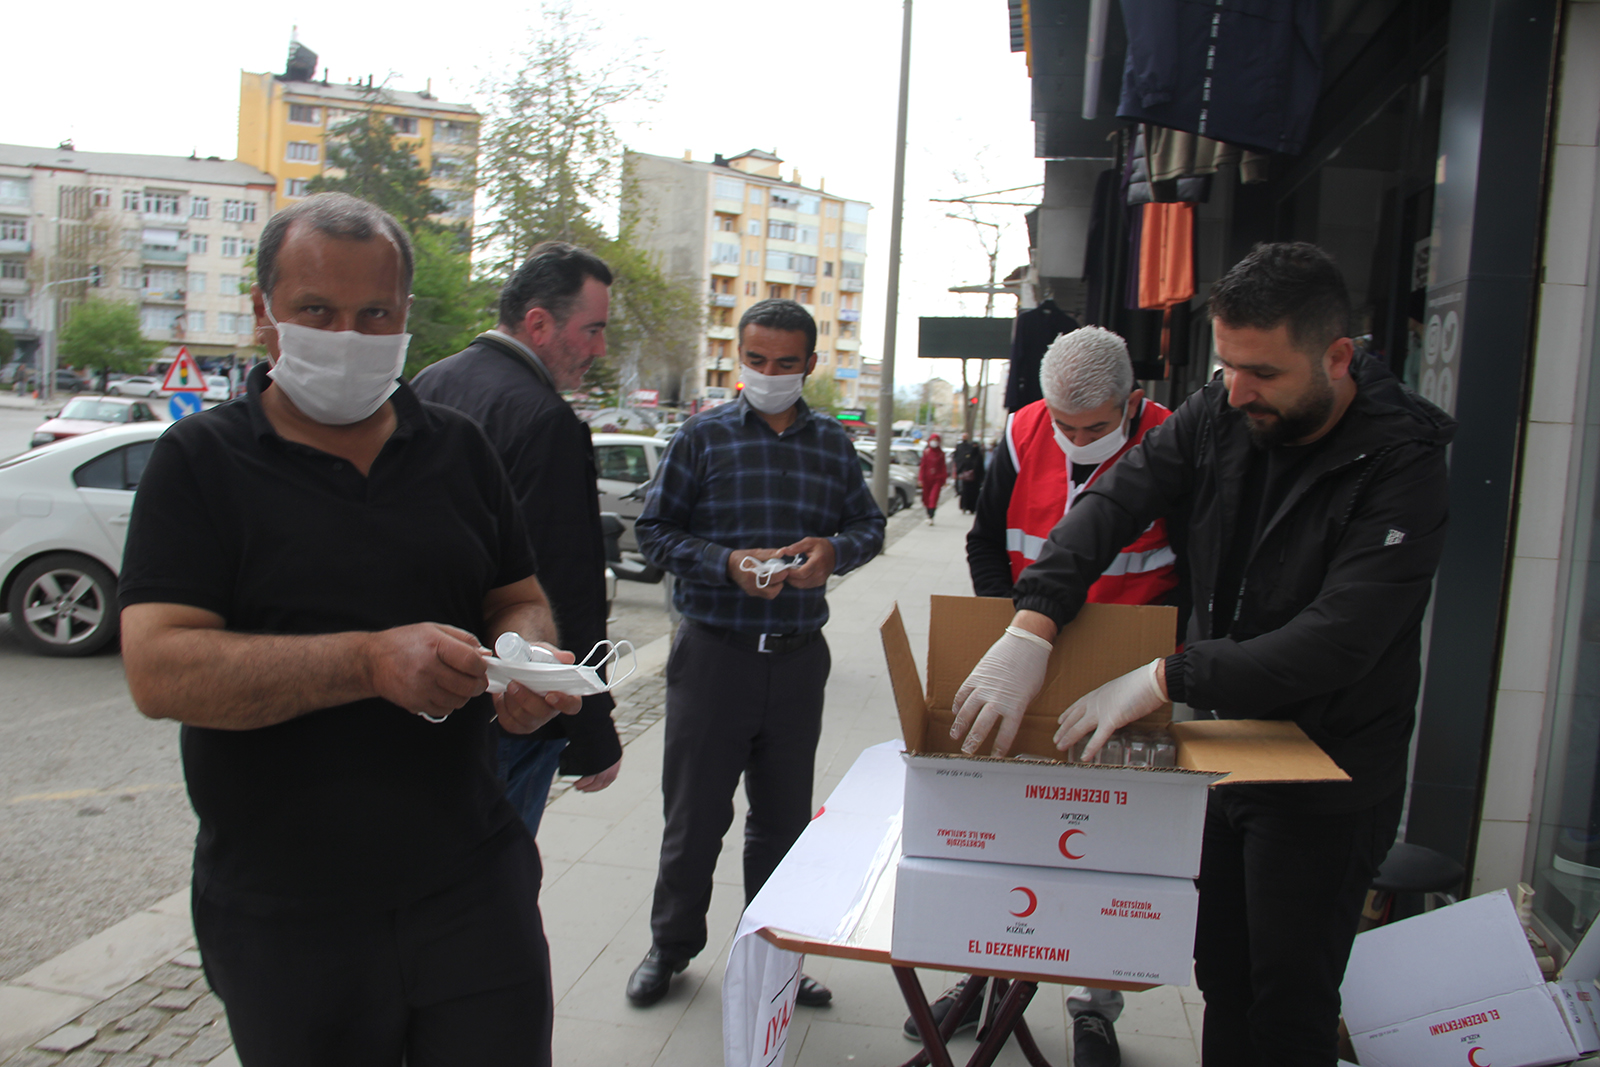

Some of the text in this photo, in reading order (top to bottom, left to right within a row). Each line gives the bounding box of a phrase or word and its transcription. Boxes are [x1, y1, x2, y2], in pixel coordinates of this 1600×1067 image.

[1025, 784, 1128, 805] EL DEZENFEKTANI
[1060, 812, 1090, 821] KIZILAY
[936, 828, 967, 838] SATILMAZ
[979, 831, 996, 841] PARA
[1111, 898, 1152, 910] ÜCRETSİZDİR
[1100, 907, 1161, 920] PARA İLE SATILMAZ
[1005, 926, 1036, 935] KIZILAY
[968, 939, 1070, 962] EL DEZENFEKTANI
[1428, 1009, 1500, 1036] EL DEZENFEKTANI
